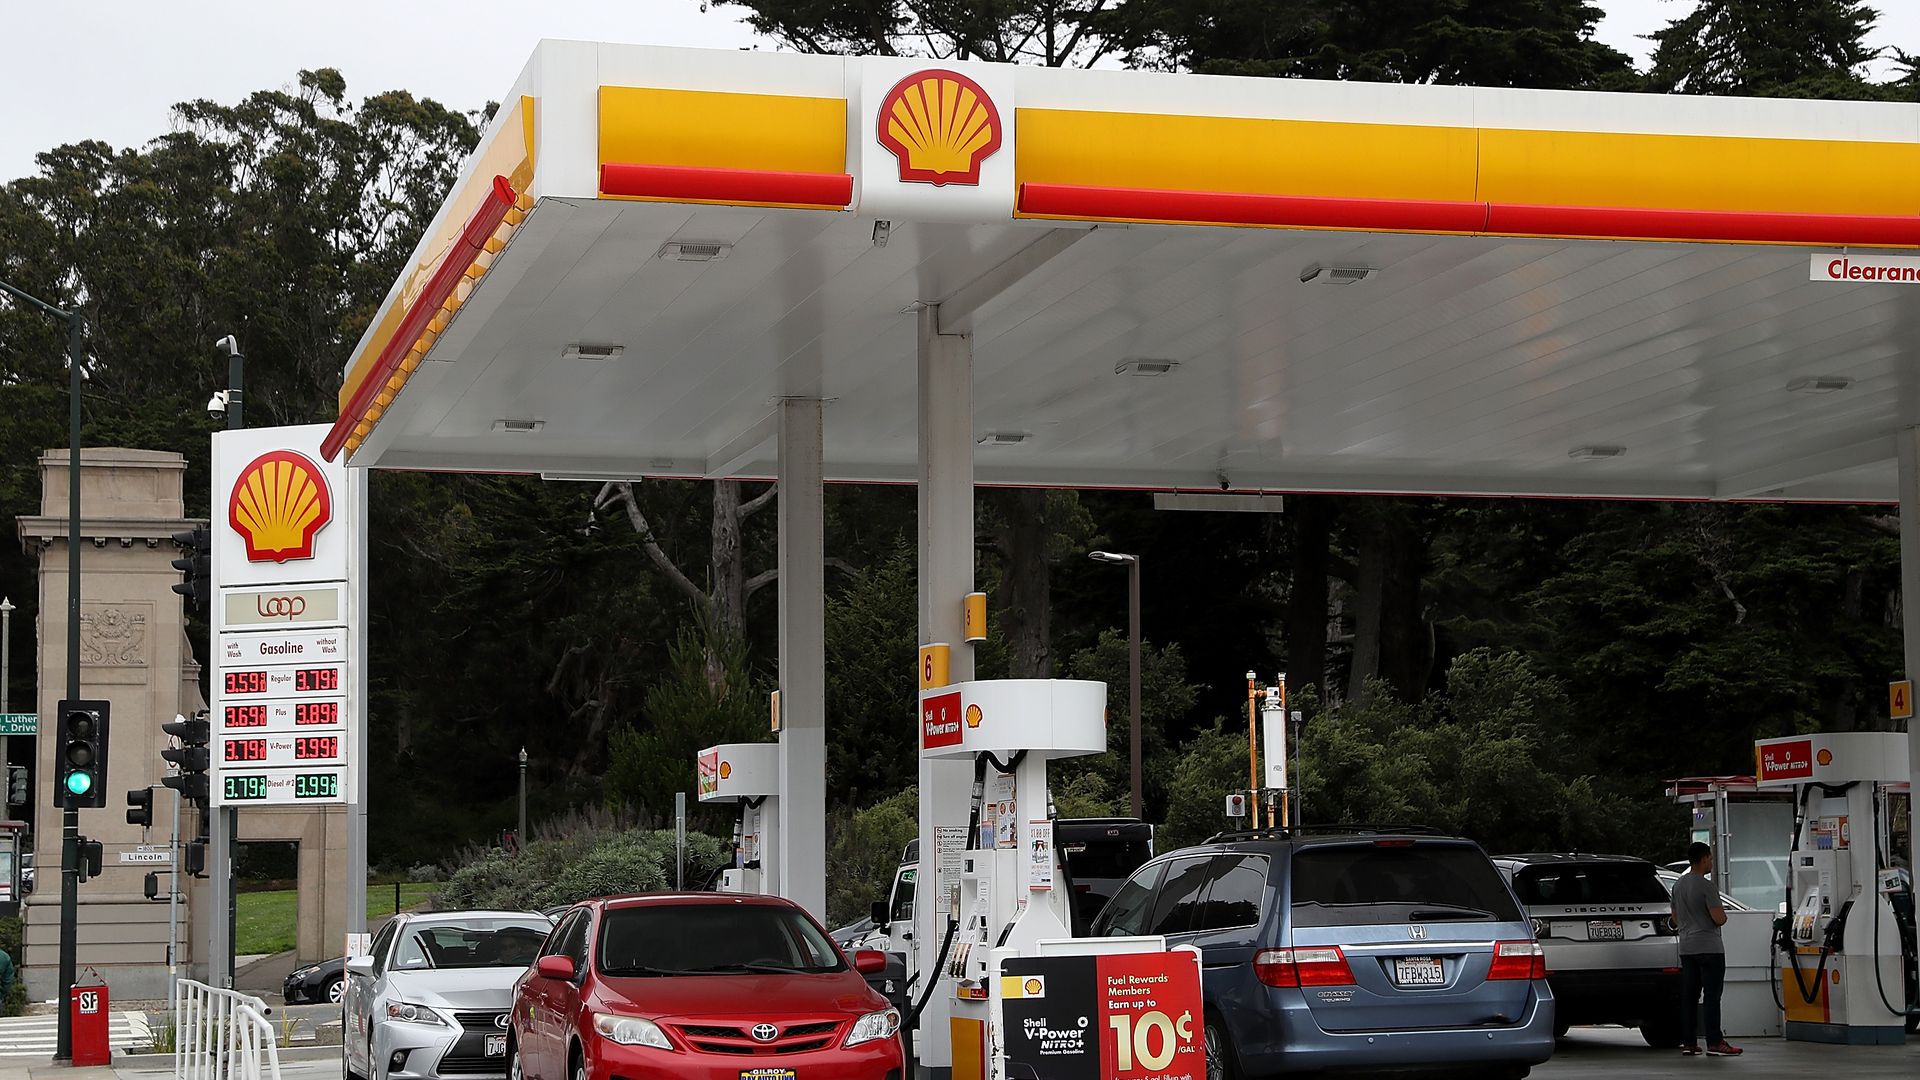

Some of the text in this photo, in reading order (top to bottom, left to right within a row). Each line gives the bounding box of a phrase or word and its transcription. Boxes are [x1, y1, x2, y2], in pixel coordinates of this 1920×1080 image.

[966, 608, 971, 627] 5
[260, 641, 304, 655] Gasoline
[227, 650, 242, 658] Wash
[925, 654, 932, 682] 6
[271, 674, 292, 684] Regular
[1895, 689, 1905, 710] 4
[275, 708, 287, 716] Plus
[5, 715, 38, 723] Luther
[0, 723, 37, 732] r. Drive
[1107, 973, 1169, 985] Fuel Rewards
[1108, 986, 1151, 996] Members
[82, 993, 97, 1010] SF
[1108, 999, 1156, 1010] Earn up to
[1023, 1017, 1047, 1028] Shell
[1024, 1027, 1084, 1040] V-Power
